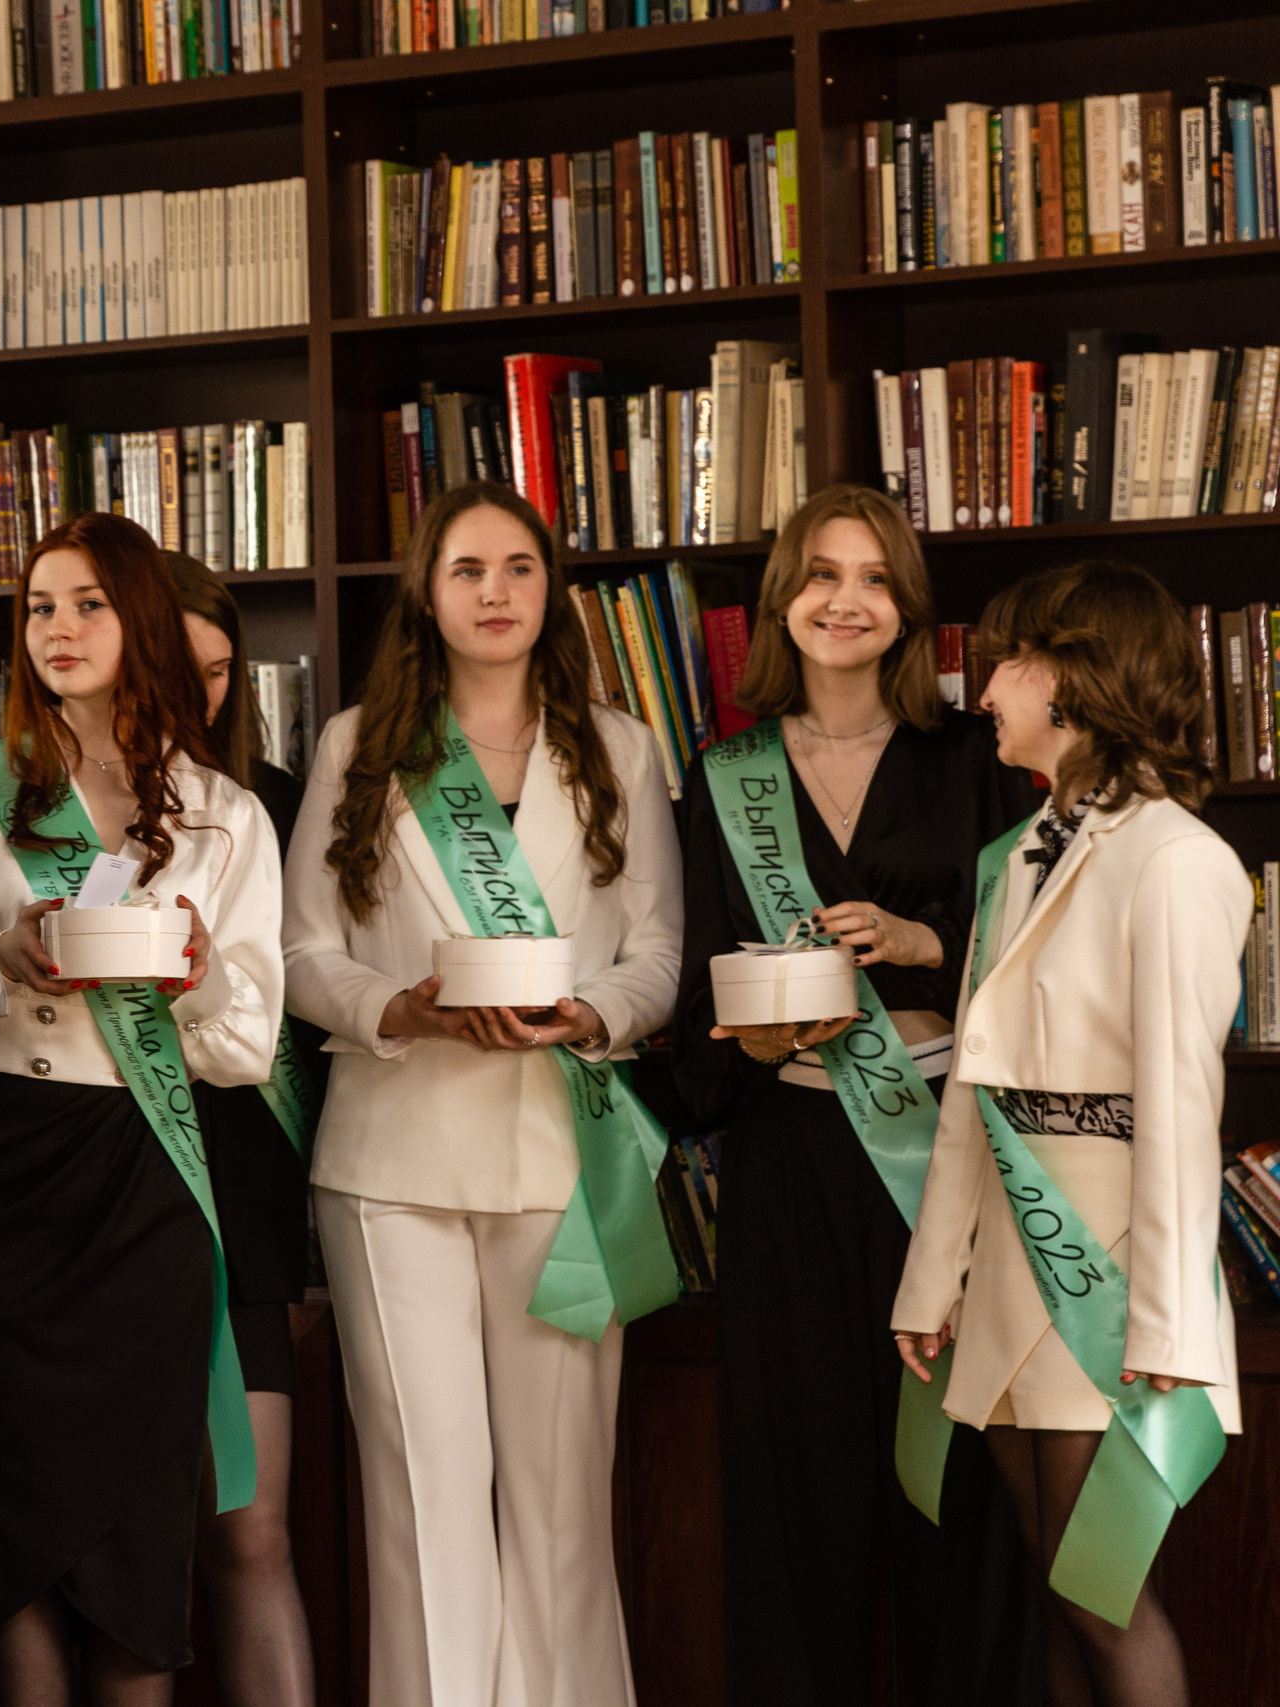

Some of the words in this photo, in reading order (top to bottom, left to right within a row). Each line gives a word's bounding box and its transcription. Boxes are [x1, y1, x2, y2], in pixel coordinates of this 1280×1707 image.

[133, 1067, 157, 1102] района
[150, 1099, 198, 1178] Санкт-Петербурга
[1004, 1185, 1105, 1298] 2023
